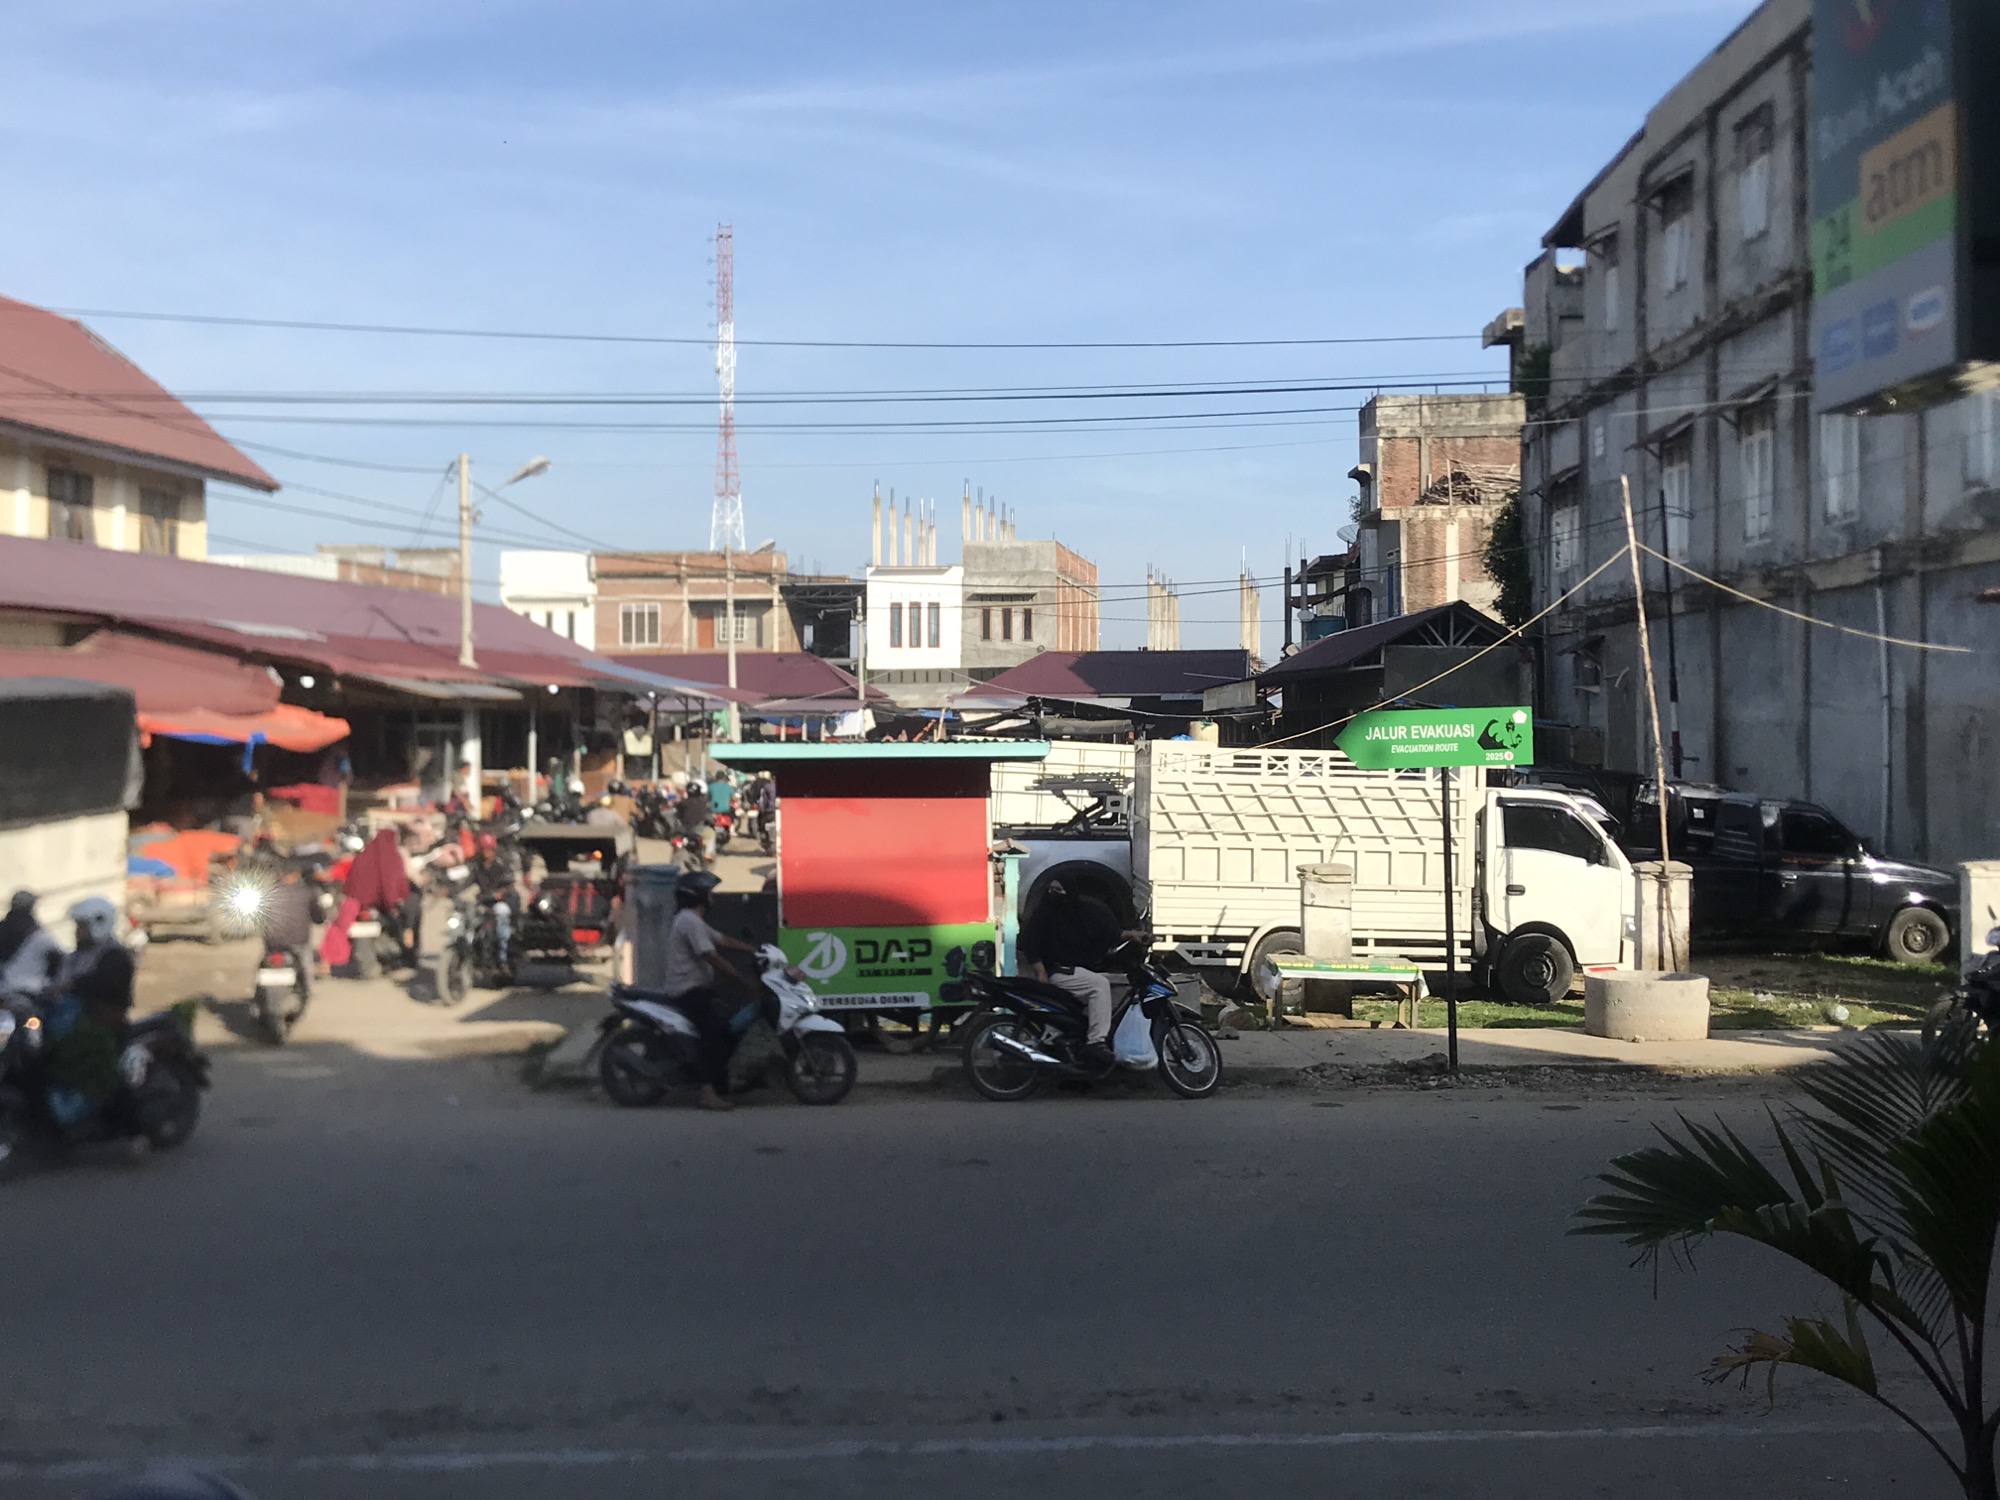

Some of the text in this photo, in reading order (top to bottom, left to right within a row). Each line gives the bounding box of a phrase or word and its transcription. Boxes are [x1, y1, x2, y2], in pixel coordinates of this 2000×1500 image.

[1365, 724, 1475, 740] JALUR EVAKUASI
[1391, 743, 1459, 754] EVACUATION ROUTE
[1485, 752, 1504, 761] 2025
[854, 939, 932, 964] DAP
[822, 995, 915, 1006] TERSEDIA DISINI
